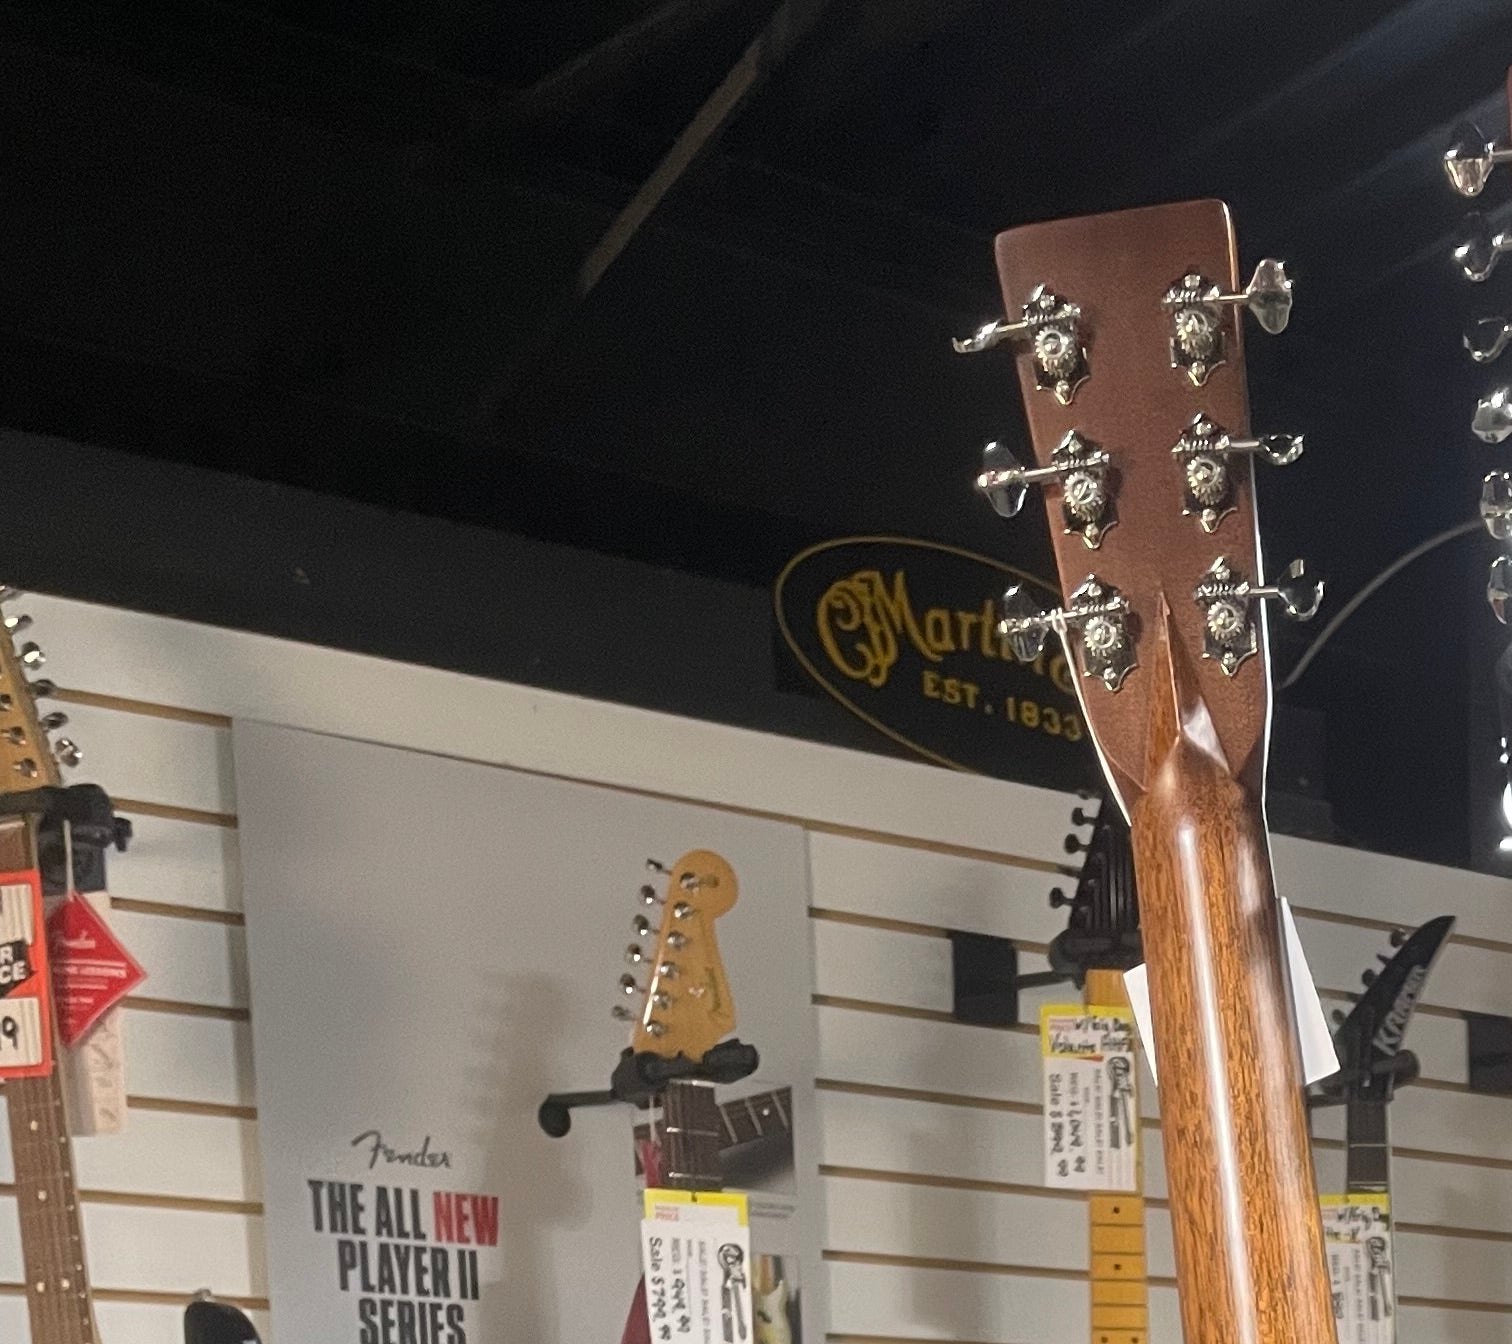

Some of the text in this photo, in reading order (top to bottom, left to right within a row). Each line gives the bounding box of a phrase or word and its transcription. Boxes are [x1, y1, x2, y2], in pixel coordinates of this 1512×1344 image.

[1006, 697, 1083, 742] 1833
[351, 1130, 451, 1169] Fender
[307, 1179, 499, 1248] THE ALL NEW
[337, 1239, 480, 1300] PLAYER II
[649, 1236, 663, 1272] Sale
